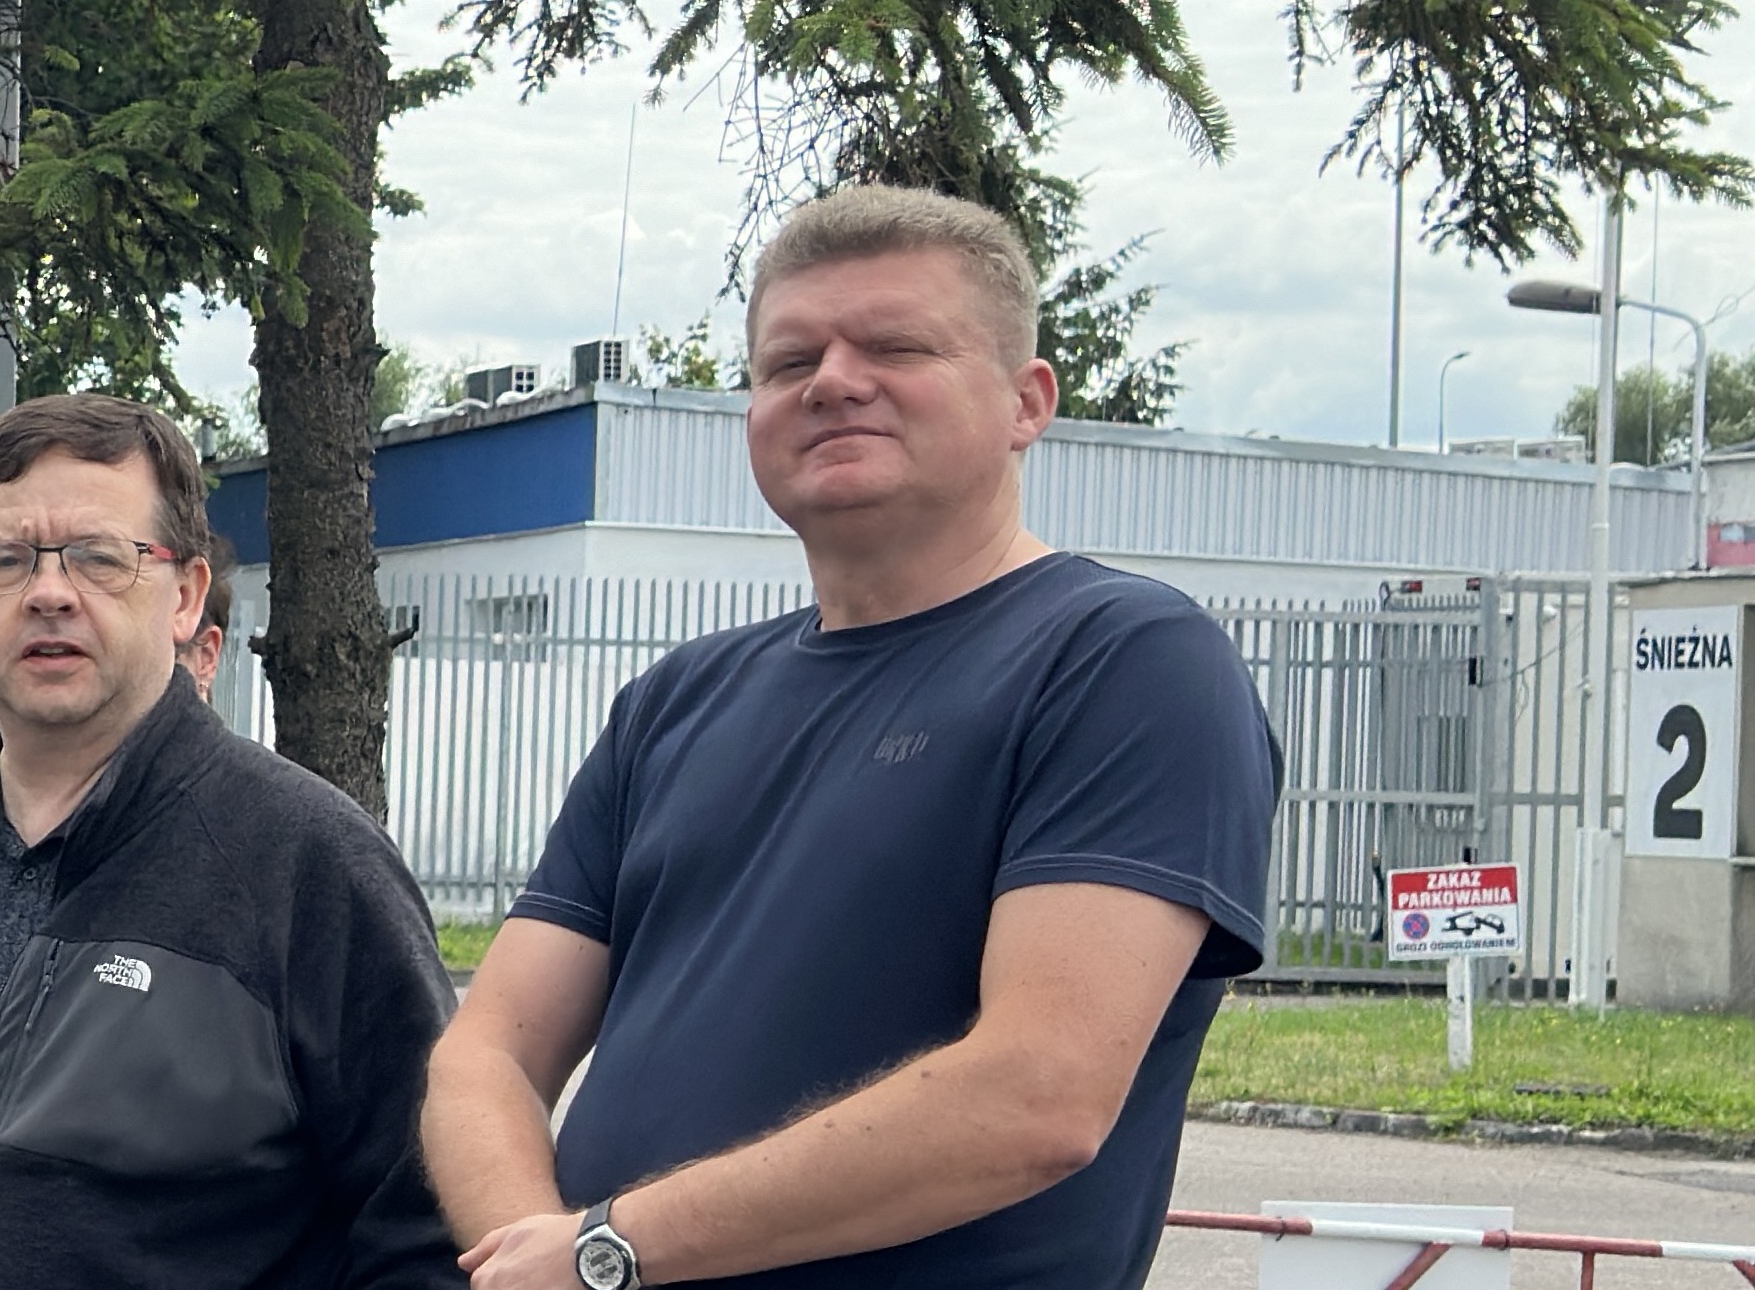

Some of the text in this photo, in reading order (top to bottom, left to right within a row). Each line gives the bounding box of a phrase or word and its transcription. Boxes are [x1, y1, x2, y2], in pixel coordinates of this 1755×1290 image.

[1653, 704, 1707, 840] 2
[1427, 871, 1482, 890] ZAKAZ
[1397, 886, 1512, 909] PARKOWANIA
[114, 954, 137, 969] THE
[93, 963, 132, 978] NORTH
[98, 973, 129, 987] FACE
